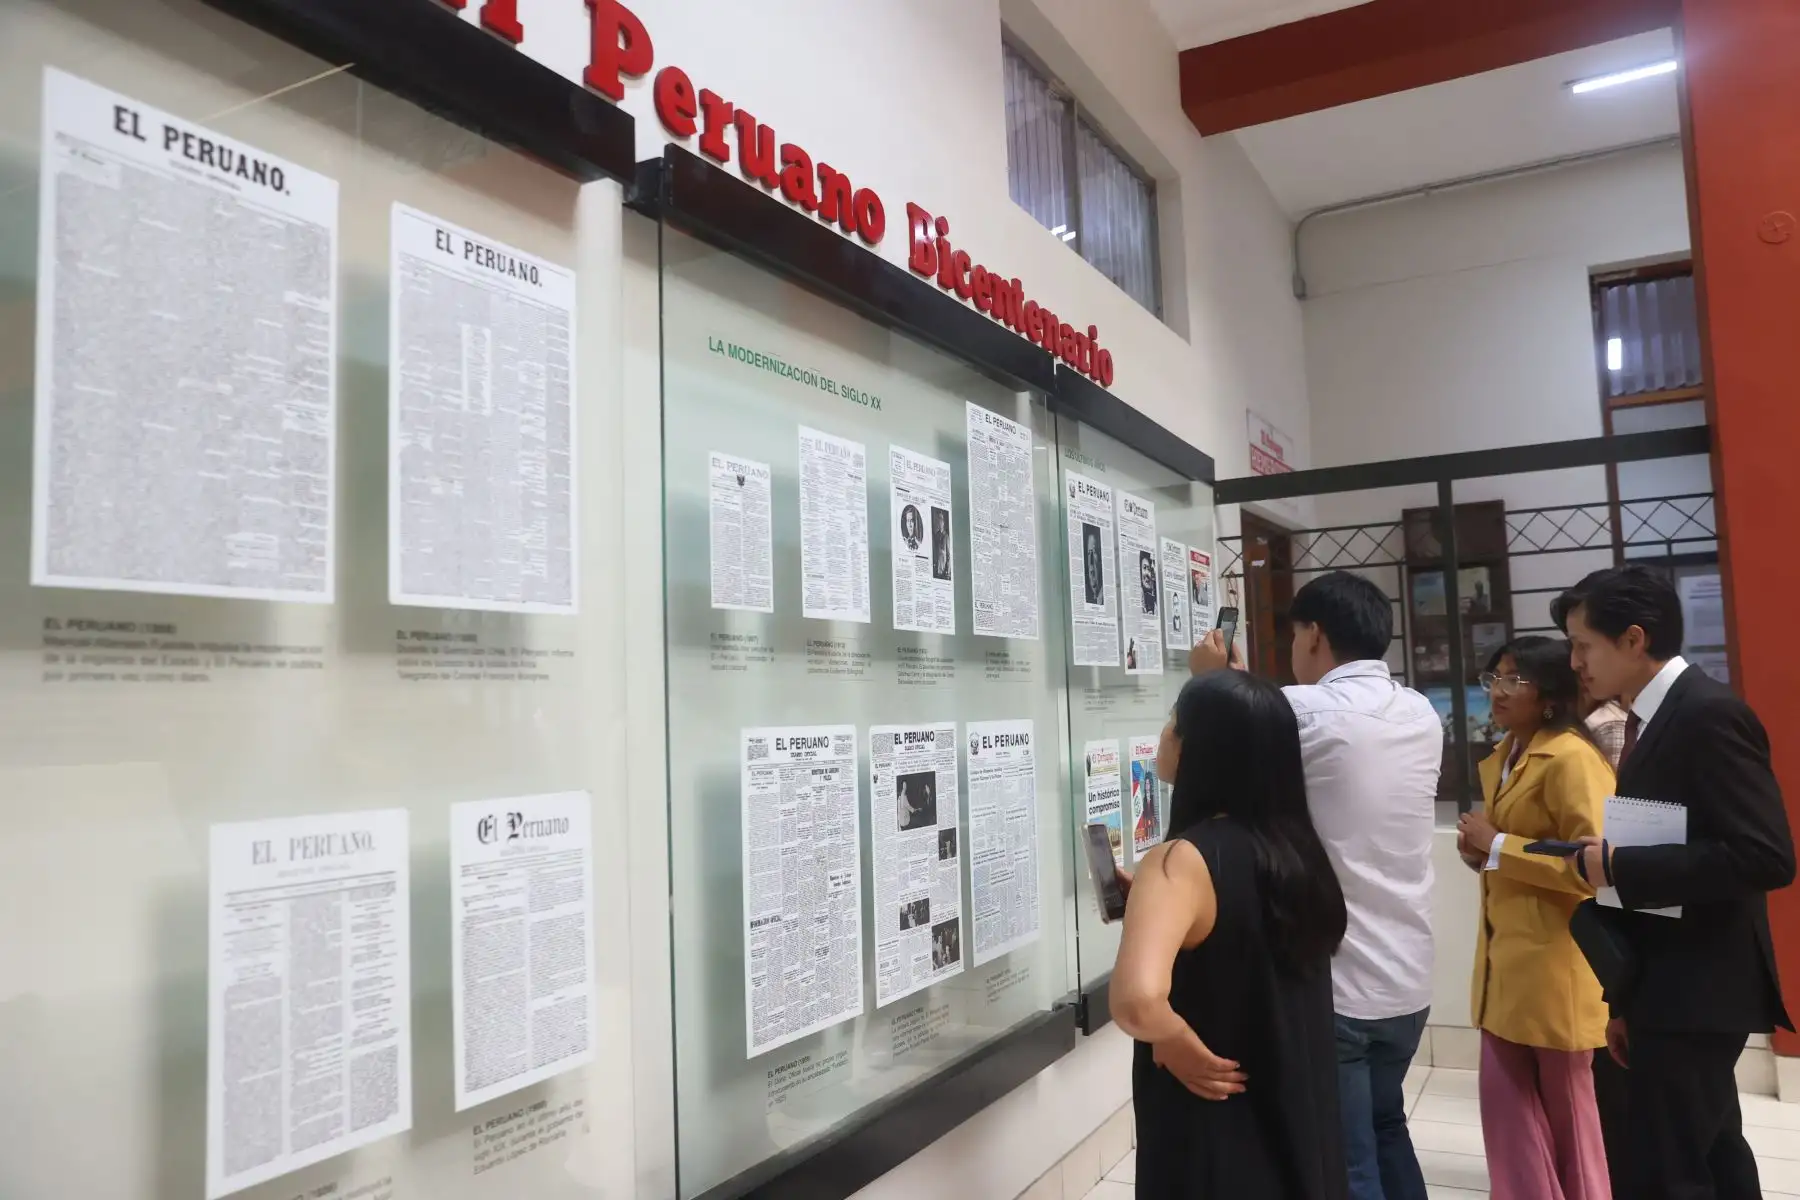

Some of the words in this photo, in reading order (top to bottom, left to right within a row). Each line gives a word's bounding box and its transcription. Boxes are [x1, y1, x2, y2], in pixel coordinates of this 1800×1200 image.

[113, 105, 147, 142] EL
[162, 124, 291, 196] PERUANO.
[584, 0, 885, 244] Peruano
[906, 202, 1113, 387] Bicentenario
[436, 228, 455, 255] EL
[463, 239, 543, 287] PERUANO.
[709, 336, 725, 355] LA
[727, 343, 818, 388] MODERNIZACION
[820, 376, 839, 396] DEL
[841, 384, 869, 407] SIGLO
[870, 396, 882, 411] XX
[712, 456, 724, 470] EL
[1078, 481, 1085, 494] EL
[776, 737, 787, 751] EL
[789, 735, 830, 750] PERUANO
[894, 733, 903, 745] EL
[904, 730, 935, 744] PERUANO
[982, 735, 993, 749] EL
[994, 732, 1030, 748] PERUANO
[1088, 791, 1096, 803] Un
[1088, 799, 1120, 816] compromiso
[477, 813, 499, 845] El
[506, 811, 569, 843] Peruano
